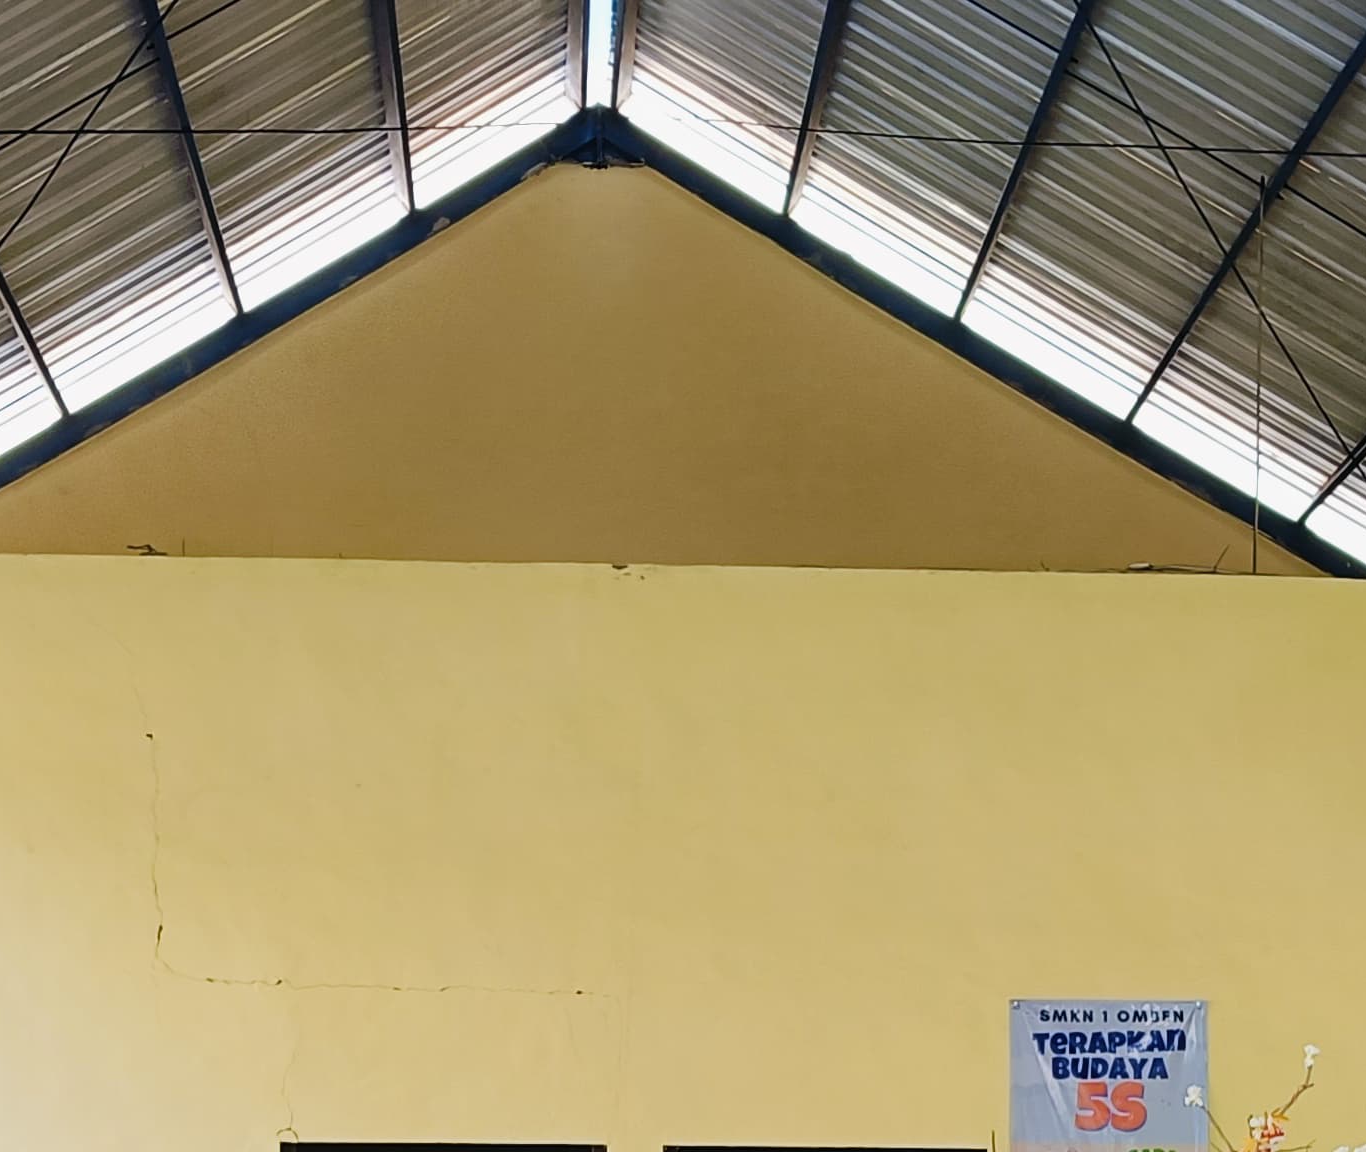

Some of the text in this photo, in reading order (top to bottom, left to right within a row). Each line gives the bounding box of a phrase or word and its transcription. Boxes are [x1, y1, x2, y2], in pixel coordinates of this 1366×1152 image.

[1039, 1009, 1093, 1023] SMKN
[1103, 1009, 1108, 1022] 1
[1051, 1057, 1169, 1080] BUDAYA
[1074, 1081, 1148, 1132] 5S
